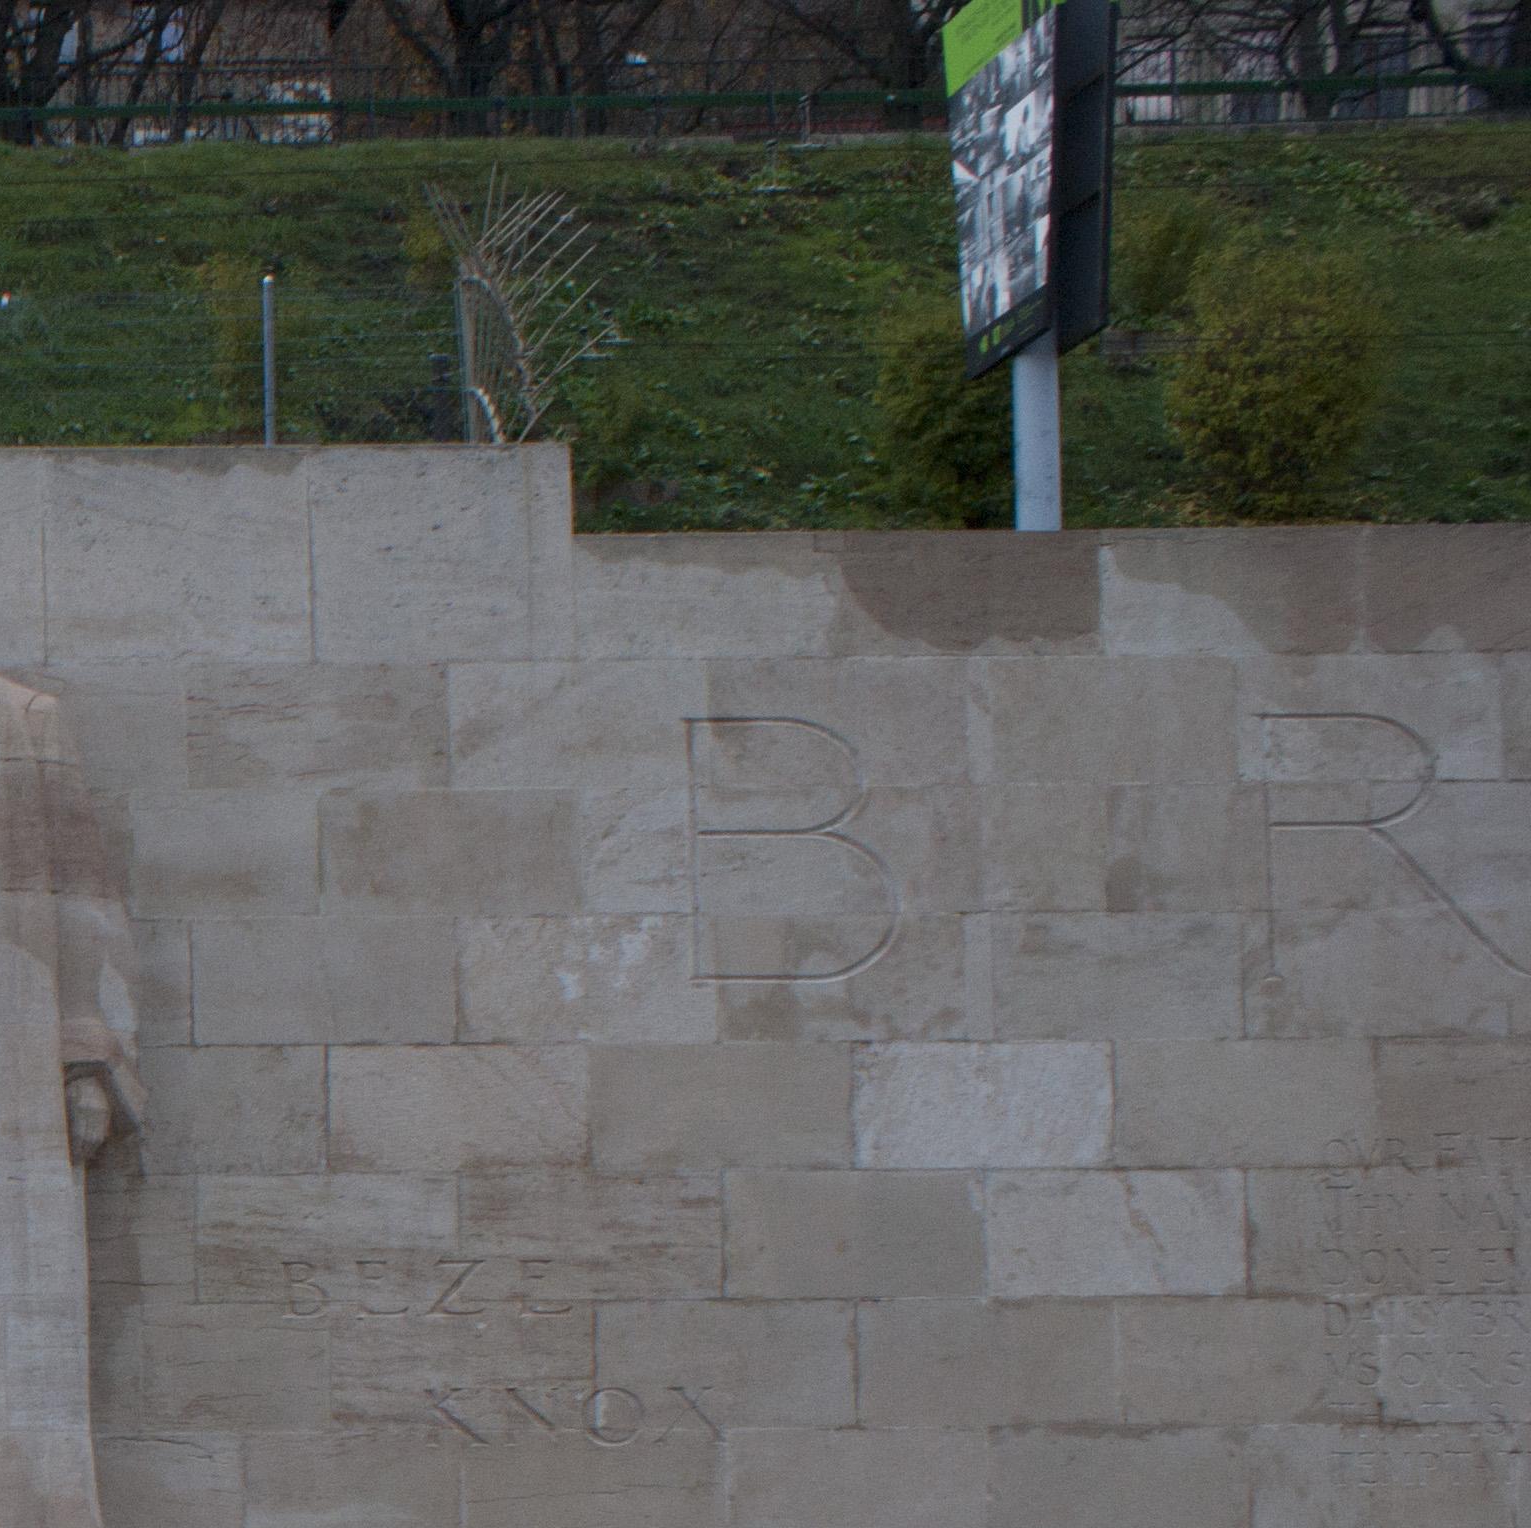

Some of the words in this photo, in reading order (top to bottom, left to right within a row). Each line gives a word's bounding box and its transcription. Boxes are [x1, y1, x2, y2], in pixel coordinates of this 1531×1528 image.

[1433, 1131, 1531, 1180] FAT
[281, 1258, 574, 1319] BEZE
[423, 1384, 729, 1447] KNOX
